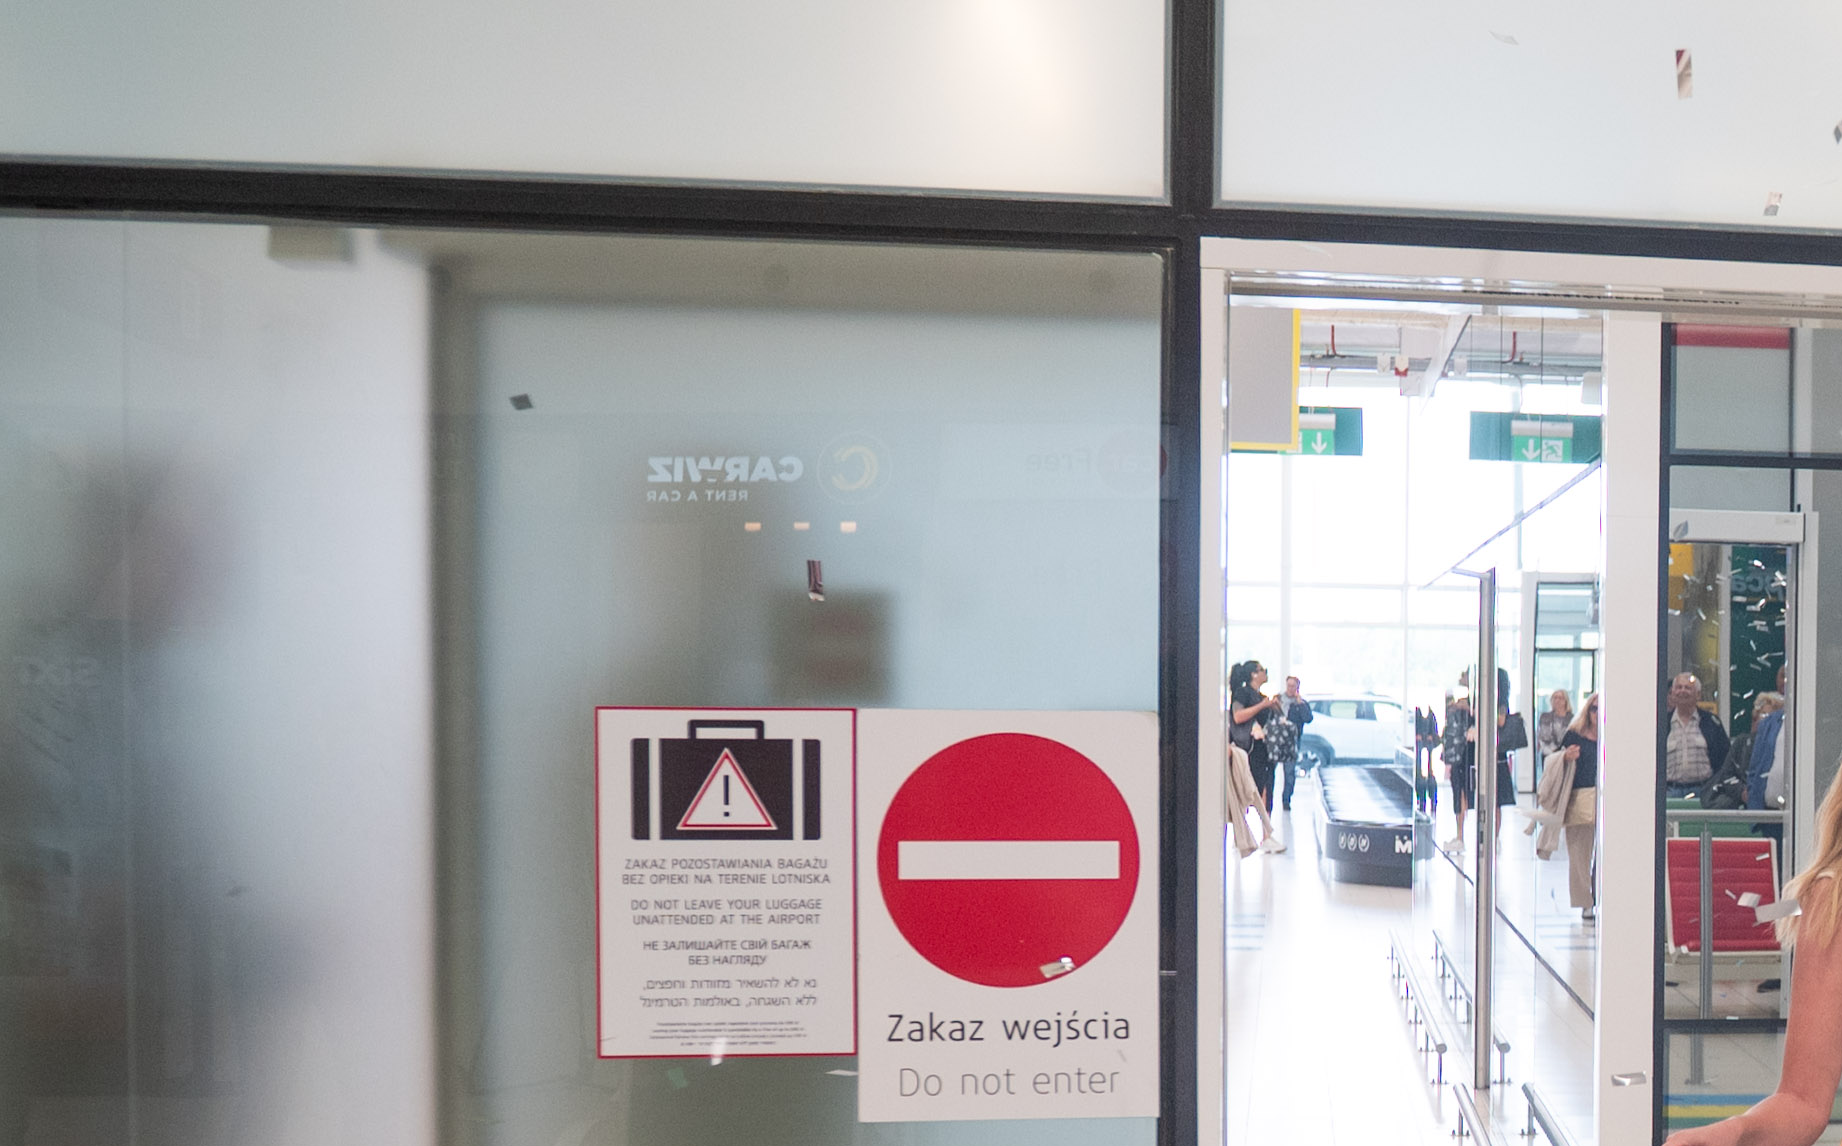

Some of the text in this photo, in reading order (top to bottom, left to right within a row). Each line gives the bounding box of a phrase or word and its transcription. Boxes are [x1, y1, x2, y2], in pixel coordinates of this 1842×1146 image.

[625, 856, 828, 869] ZAKAZ POZOSTAWIANIA BAGAŻU
[622, 874, 830, 884] BEZ OPIEKI NA TERENIE LOTNISKA
[631, 899, 822, 910] DO NOT LEAVE YOUR LUGGAGE
[633, 914, 820, 925] UNATTENDED AT THE AIRPORT
[643, 938, 811, 950] НЕ ЗАЛИШАЙТЕ СВІЙ БАГАЖ
[689, 955, 767, 967] БЕЗ НАГЛЯДУ
[784, 976, 799, 988] לא
[887, 1010, 1130, 1048] Zakaz wejścia
[899, 1066, 1120, 1098] Do not enter
